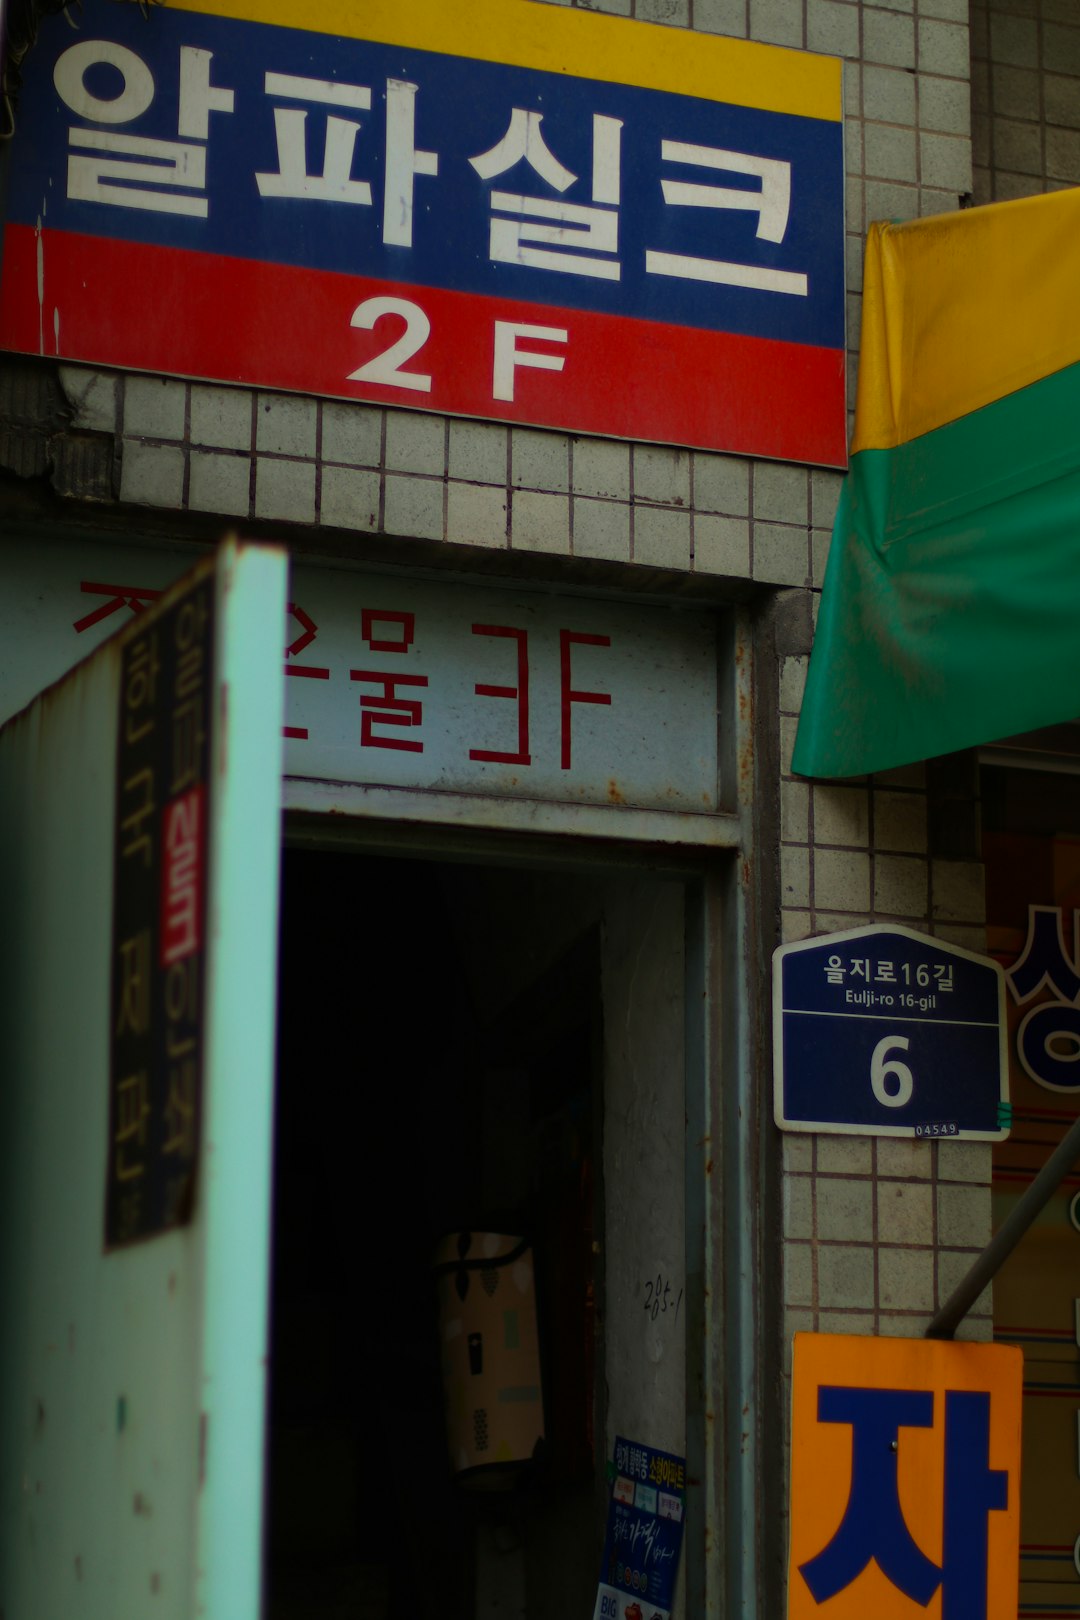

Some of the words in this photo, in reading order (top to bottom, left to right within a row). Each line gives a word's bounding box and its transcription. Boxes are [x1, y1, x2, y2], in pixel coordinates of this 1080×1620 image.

[823, 954, 954, 993] 을지로16길
[845, 989, 895, 1009] Eulji-ro
[898, 993, 937, 1011] 16-gil
[869, 1034, 914, 1108] 6
[915, 1123, 957, 1137] 04549
